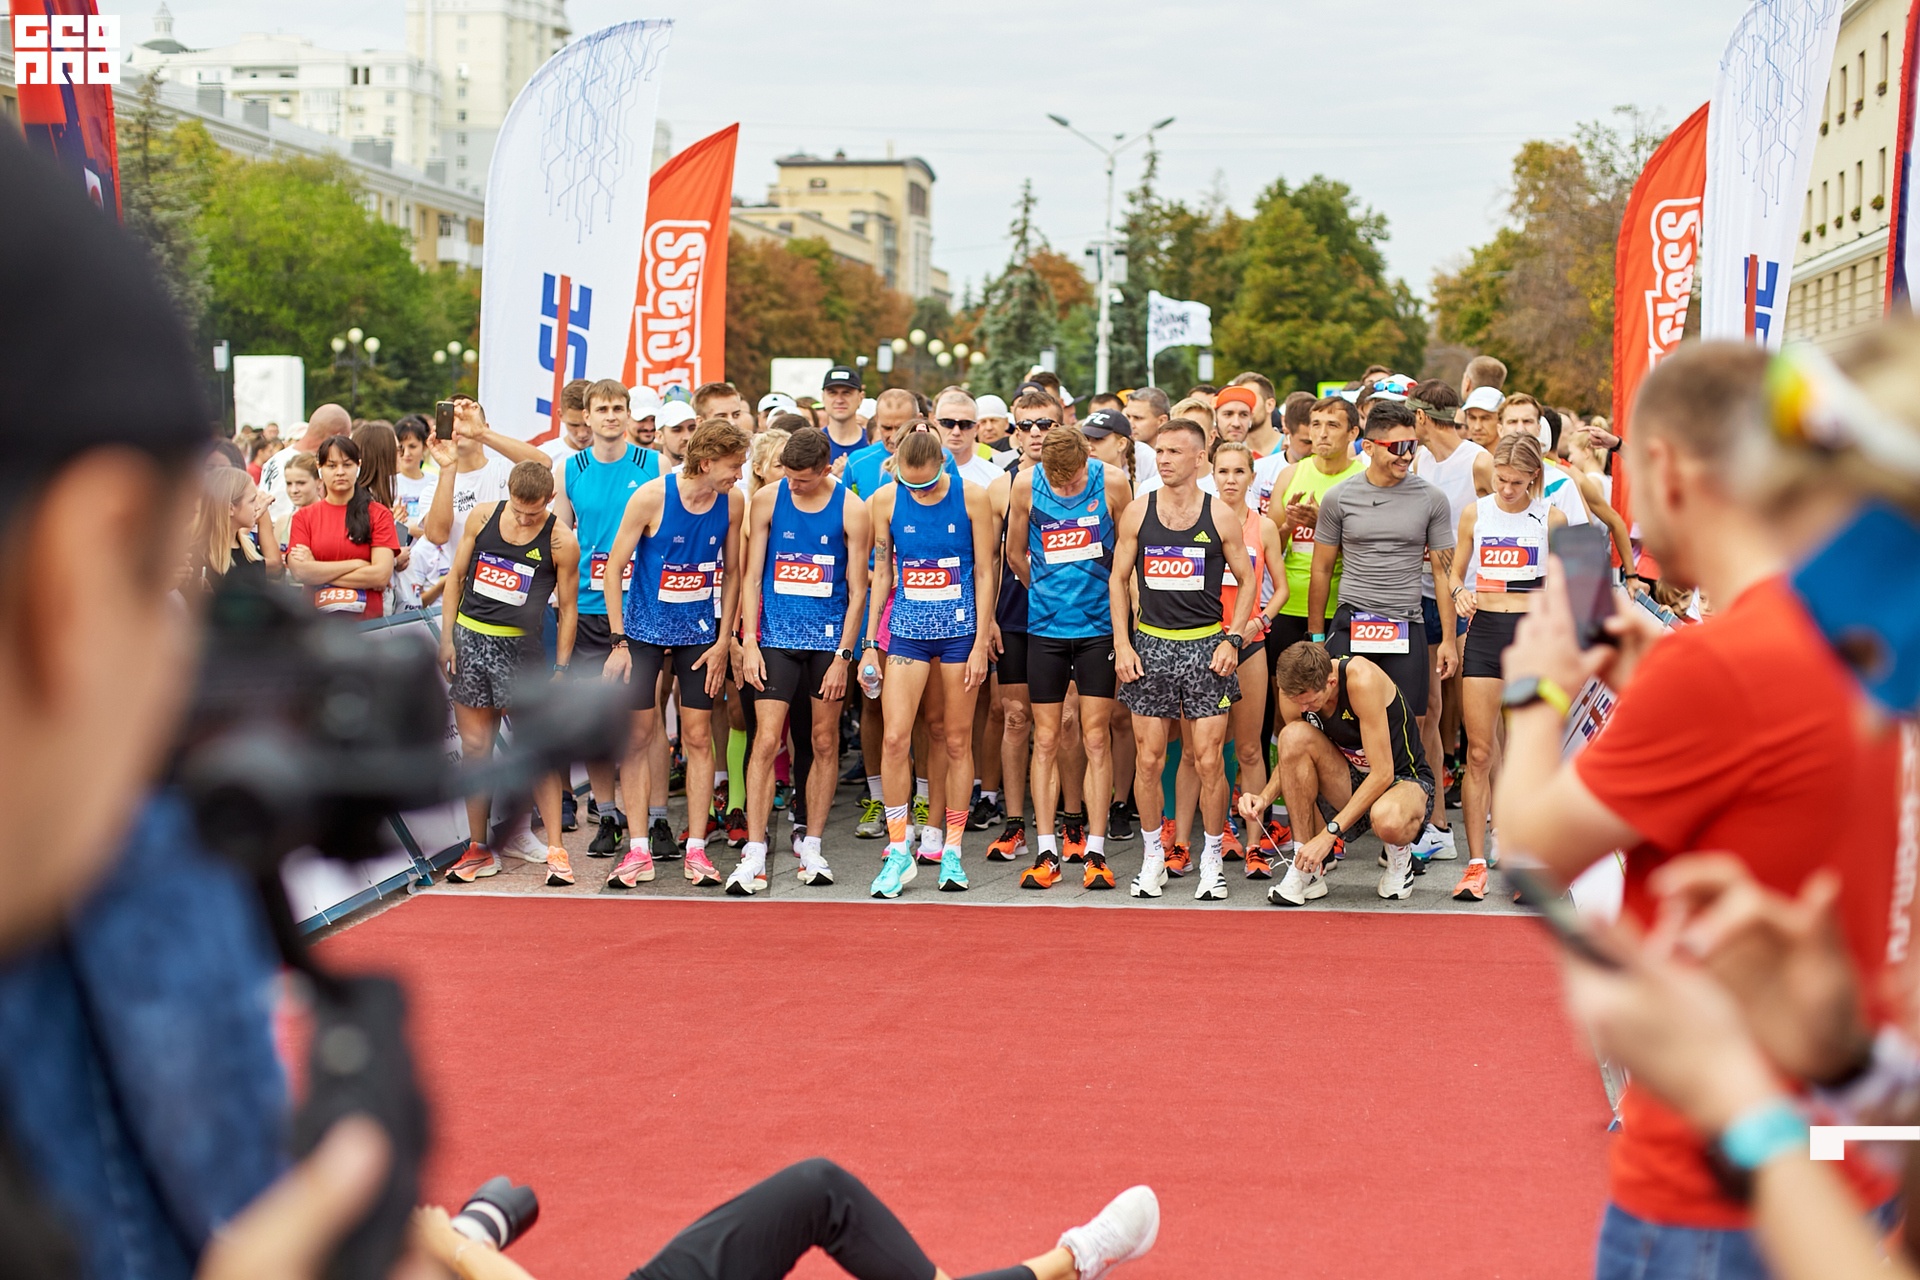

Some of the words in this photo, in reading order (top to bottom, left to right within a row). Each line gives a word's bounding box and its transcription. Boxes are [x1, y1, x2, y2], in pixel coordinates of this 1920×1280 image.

[646, 231, 706, 362] Class
[1046, 530, 1087, 549] 2327
[1483, 549, 1520, 565] 2101
[778, 564, 820, 581] 2324
[1147, 559, 1194, 575] 2000
[478, 566, 518, 589] 2326
[663, 575, 704, 589] 2325
[906, 571, 947, 586] 2323
[318, 589, 355, 603] 5433
[1354, 624, 1395, 639] 2075
